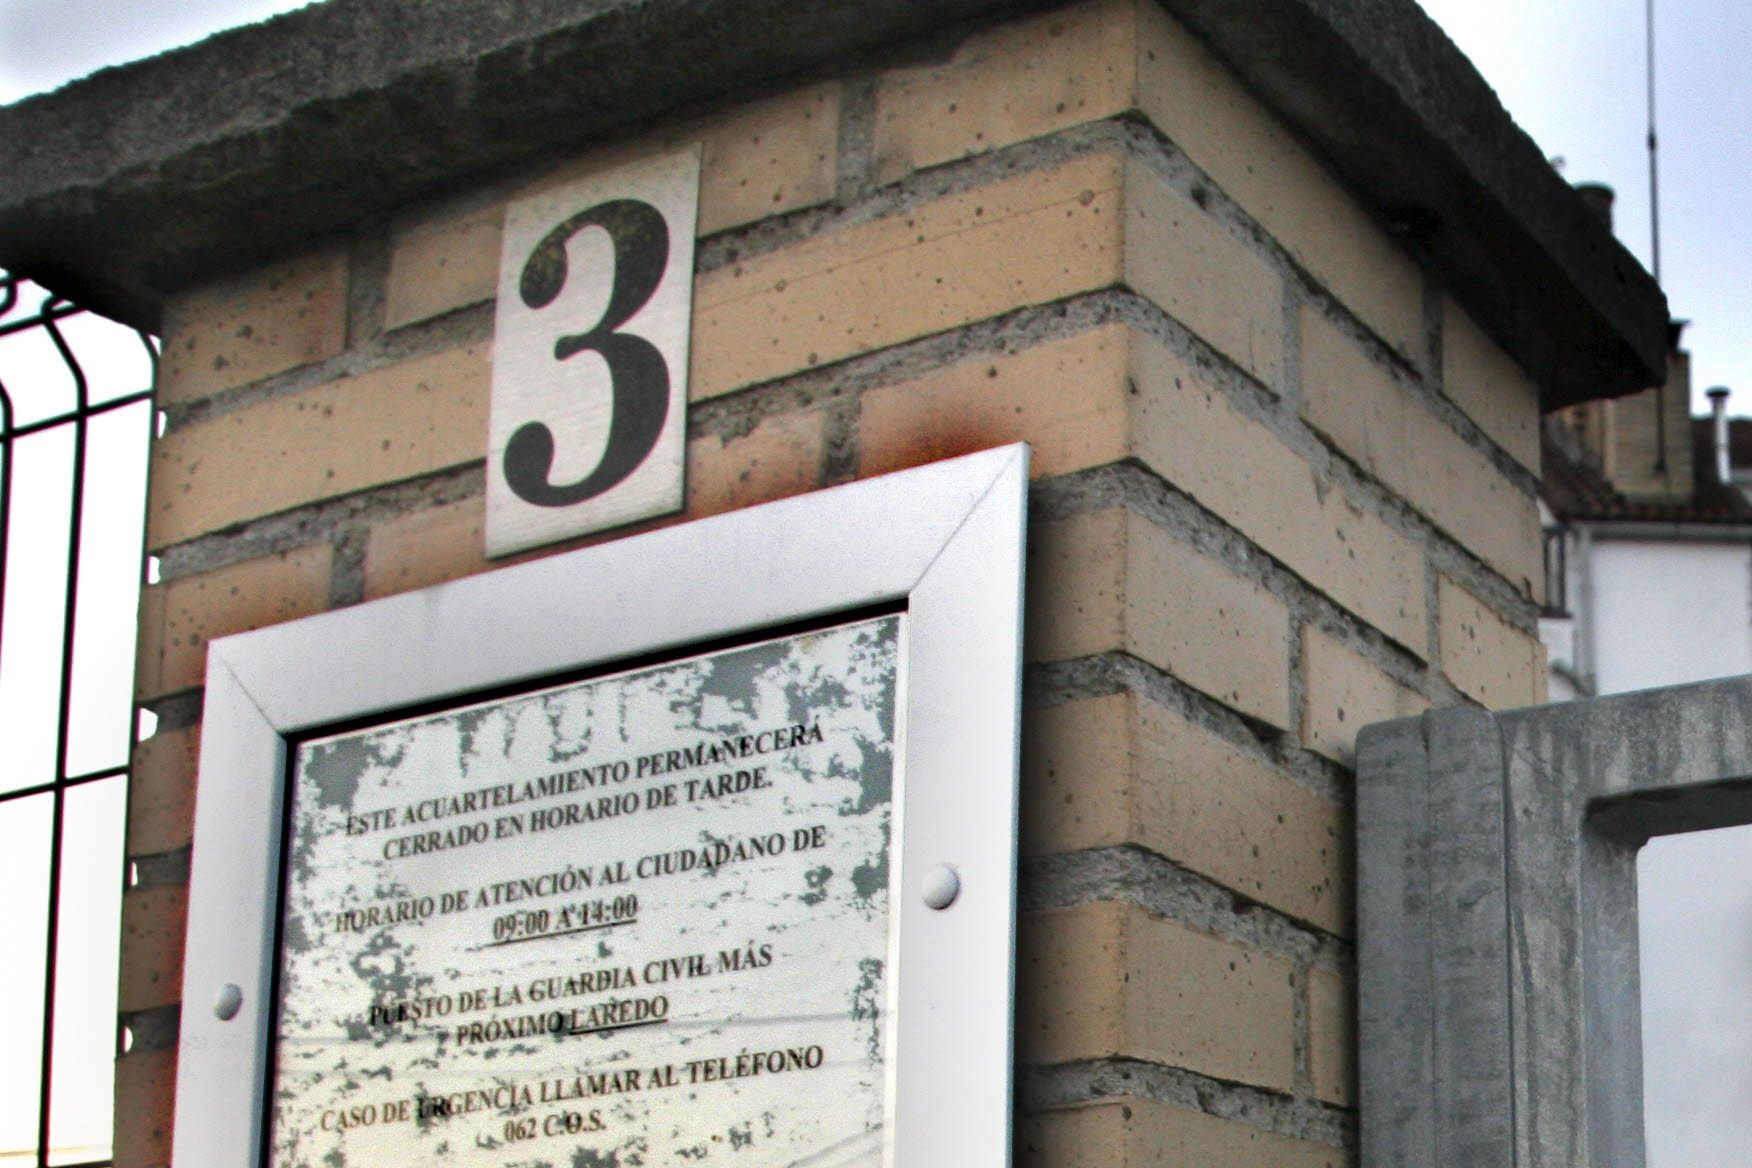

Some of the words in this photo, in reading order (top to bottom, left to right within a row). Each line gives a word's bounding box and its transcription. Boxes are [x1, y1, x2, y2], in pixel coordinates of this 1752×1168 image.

[503, 198, 669, 507] 3
[347, 807, 397, 836] ESTE
[402, 761, 629, 825] ACUARTELAMIENTO
[636, 715, 824, 779] PERMANECERÁ
[383, 821, 489, 860] CERRADO
[495, 813, 524, 838] EN
[529, 792, 640, 832] HORARIO
[646, 784, 678, 810] DE
[684, 767, 773, 802] TARDE.
[334, 897, 435, 933] HORARIO
[440, 890, 469, 915] DE
[475, 863, 594, 907] ATENCIÓN
[600, 861, 631, 885] AL
[636, 833, 785, 879] CIUDADANO
[793, 825, 826, 851] DE
[493, 909, 549, 939] 09:00
[555, 904, 576, 929] A
[578, 894, 638, 925] 14:00
[369, 995, 451, 1027] PUESTO
[459, 989, 487, 1013] DE
[493, 985, 522, 1008] LA
[529, 967, 637, 1002] GUARDIA
[643, 953, 711, 984] CIVIL
[718, 940, 773, 973] MÁS
[456, 1012, 564, 1046] PRÓXIMO
[570, 995, 670, 1032] LAREDO
[320, 1103, 376, 1131] CASO
[382, 1099, 411, 1124] DE
[416, 1082, 533, 1120] URGENCIA
[540, 1069, 642, 1103] LLAMAR
[648, 1065, 680, 1090] AL
[686, 1045, 823, 1084] TELÉFONO
[504, 1117, 537, 1142] 062
[543, 1109, 606, 1138] C.O.S.
